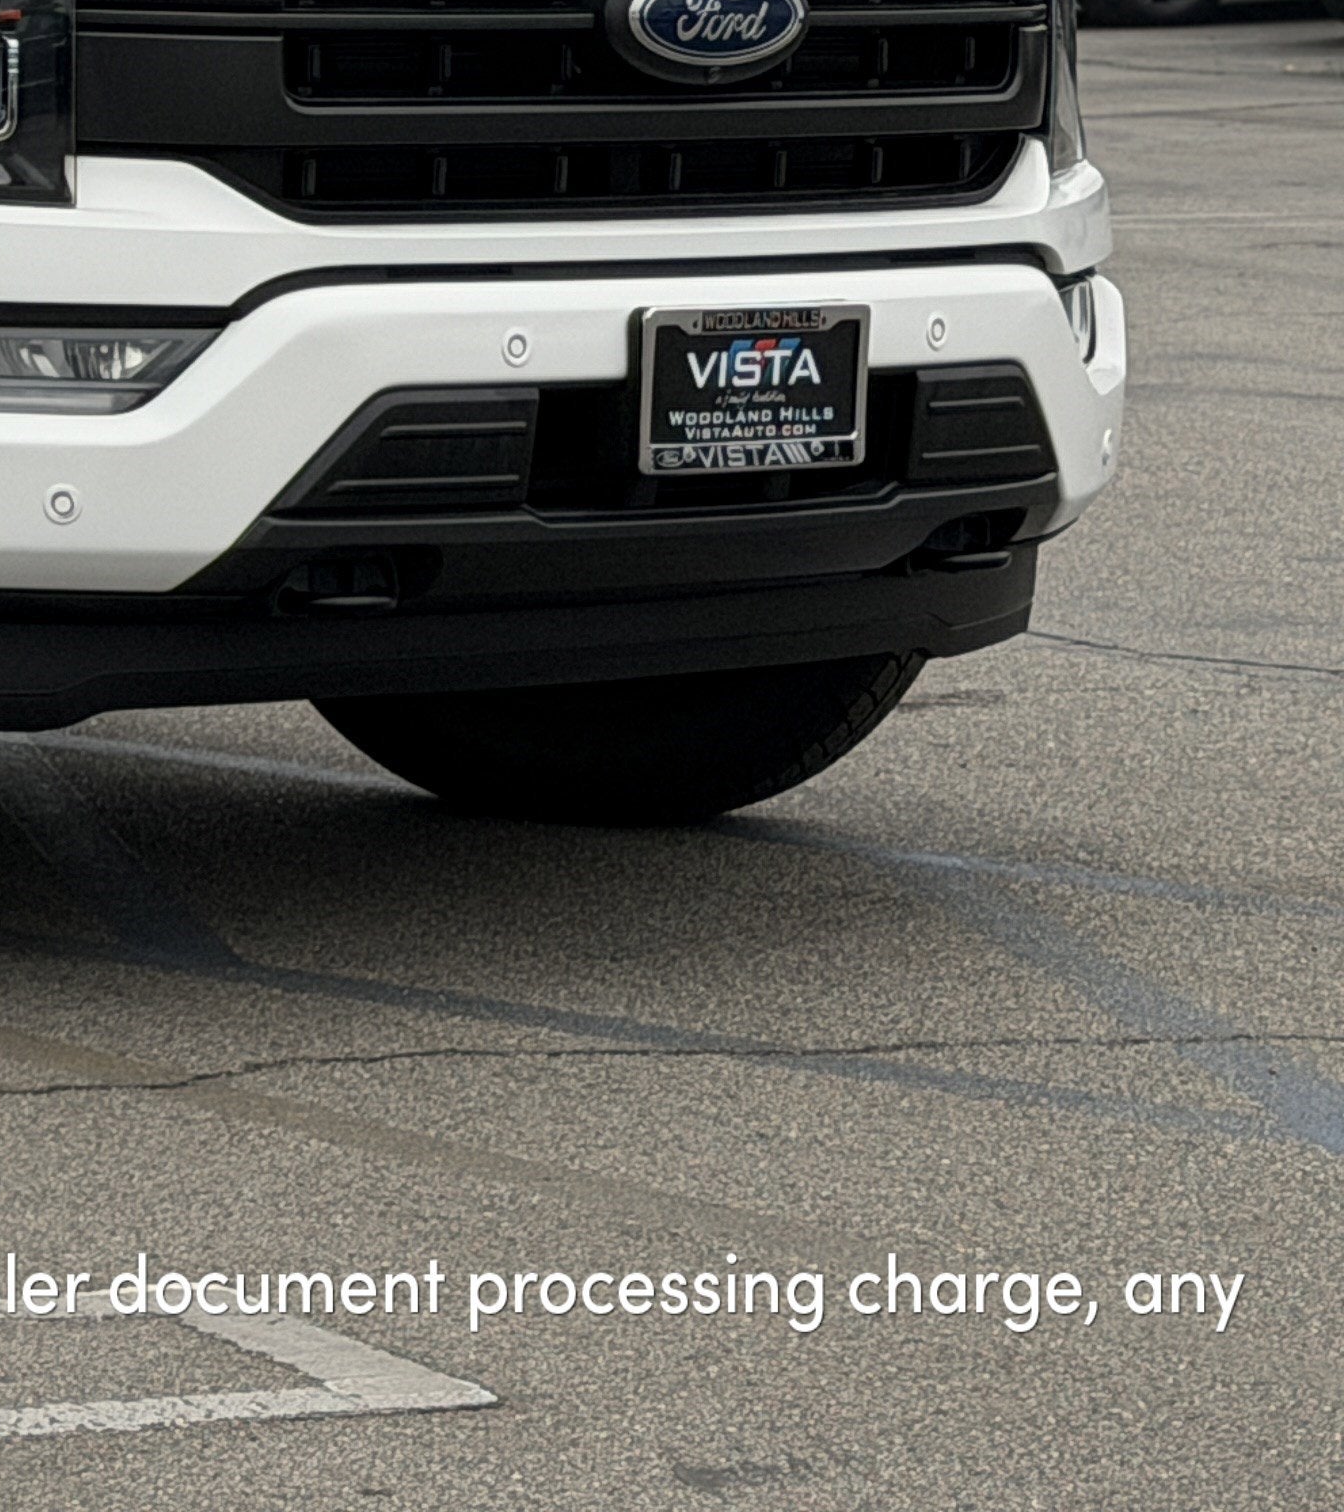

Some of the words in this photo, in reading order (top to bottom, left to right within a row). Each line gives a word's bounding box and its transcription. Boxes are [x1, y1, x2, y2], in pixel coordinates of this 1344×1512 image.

[704, 311, 781, 330] WOODLAND
[686, 347, 821, 389] VISTA
[668, 408, 773, 426] WOODLAND
[779, 406, 835, 422] HILLS
[698, 443, 787, 469] VISTA
